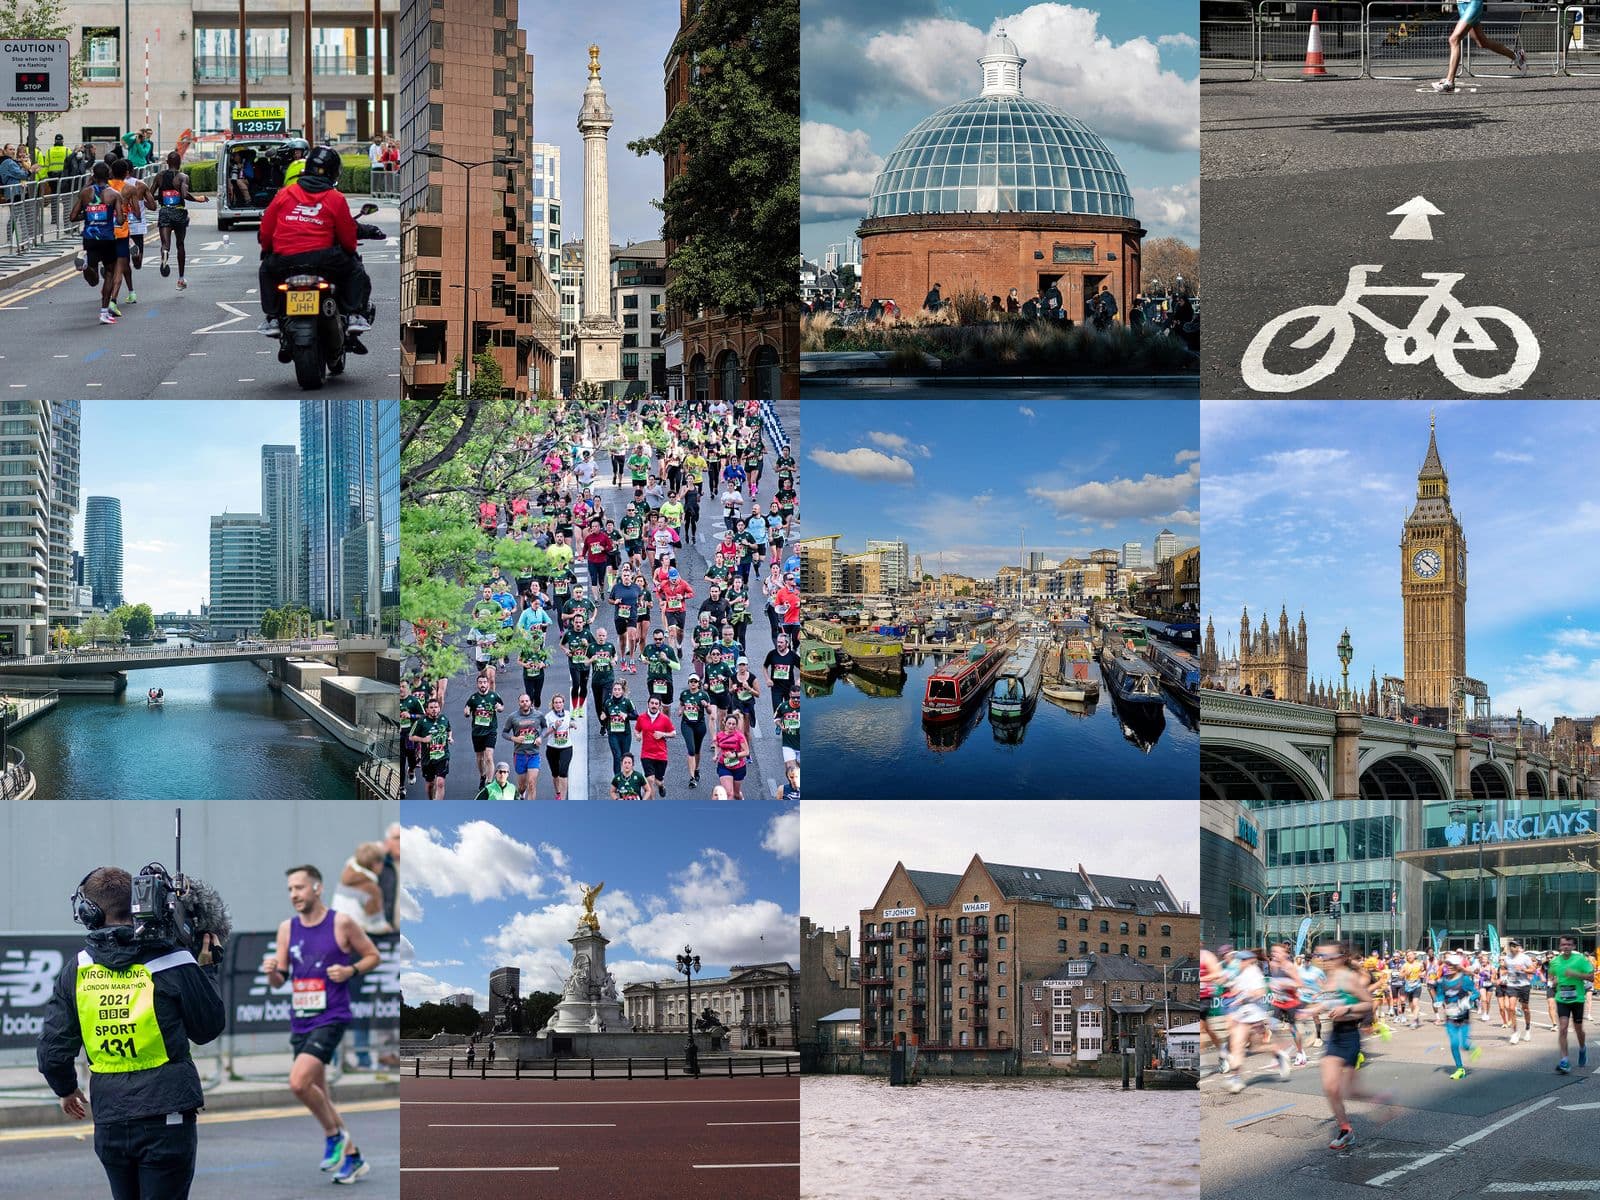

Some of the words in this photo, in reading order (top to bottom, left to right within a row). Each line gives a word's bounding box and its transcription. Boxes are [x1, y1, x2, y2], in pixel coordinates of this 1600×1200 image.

[4, 44, 55, 53] CAUTION
[236, 110, 259, 118] RACE
[262, 109, 281, 117] TIME
[237, 121, 282, 133] 1:29:57
[298, 215, 324, 225] balance
[290, 292, 316, 303] RJ21
[291, 302, 315, 313] JHH
[1471, 811, 1590, 842] BARCLAYS
[963, 903, 989, 912] WHARF
[81, 970, 114, 979] VIRGIN
[116, 969, 145, 979] MONE
[110, 982, 147, 990] MARATHON
[99, 994, 130, 1006] 2021
[99, 1008, 130, 1019] BBC
[236, 1004, 264, 1022] new
[95, 1023, 137, 1036] SPORT
[100, 1037, 137, 1058] 131
